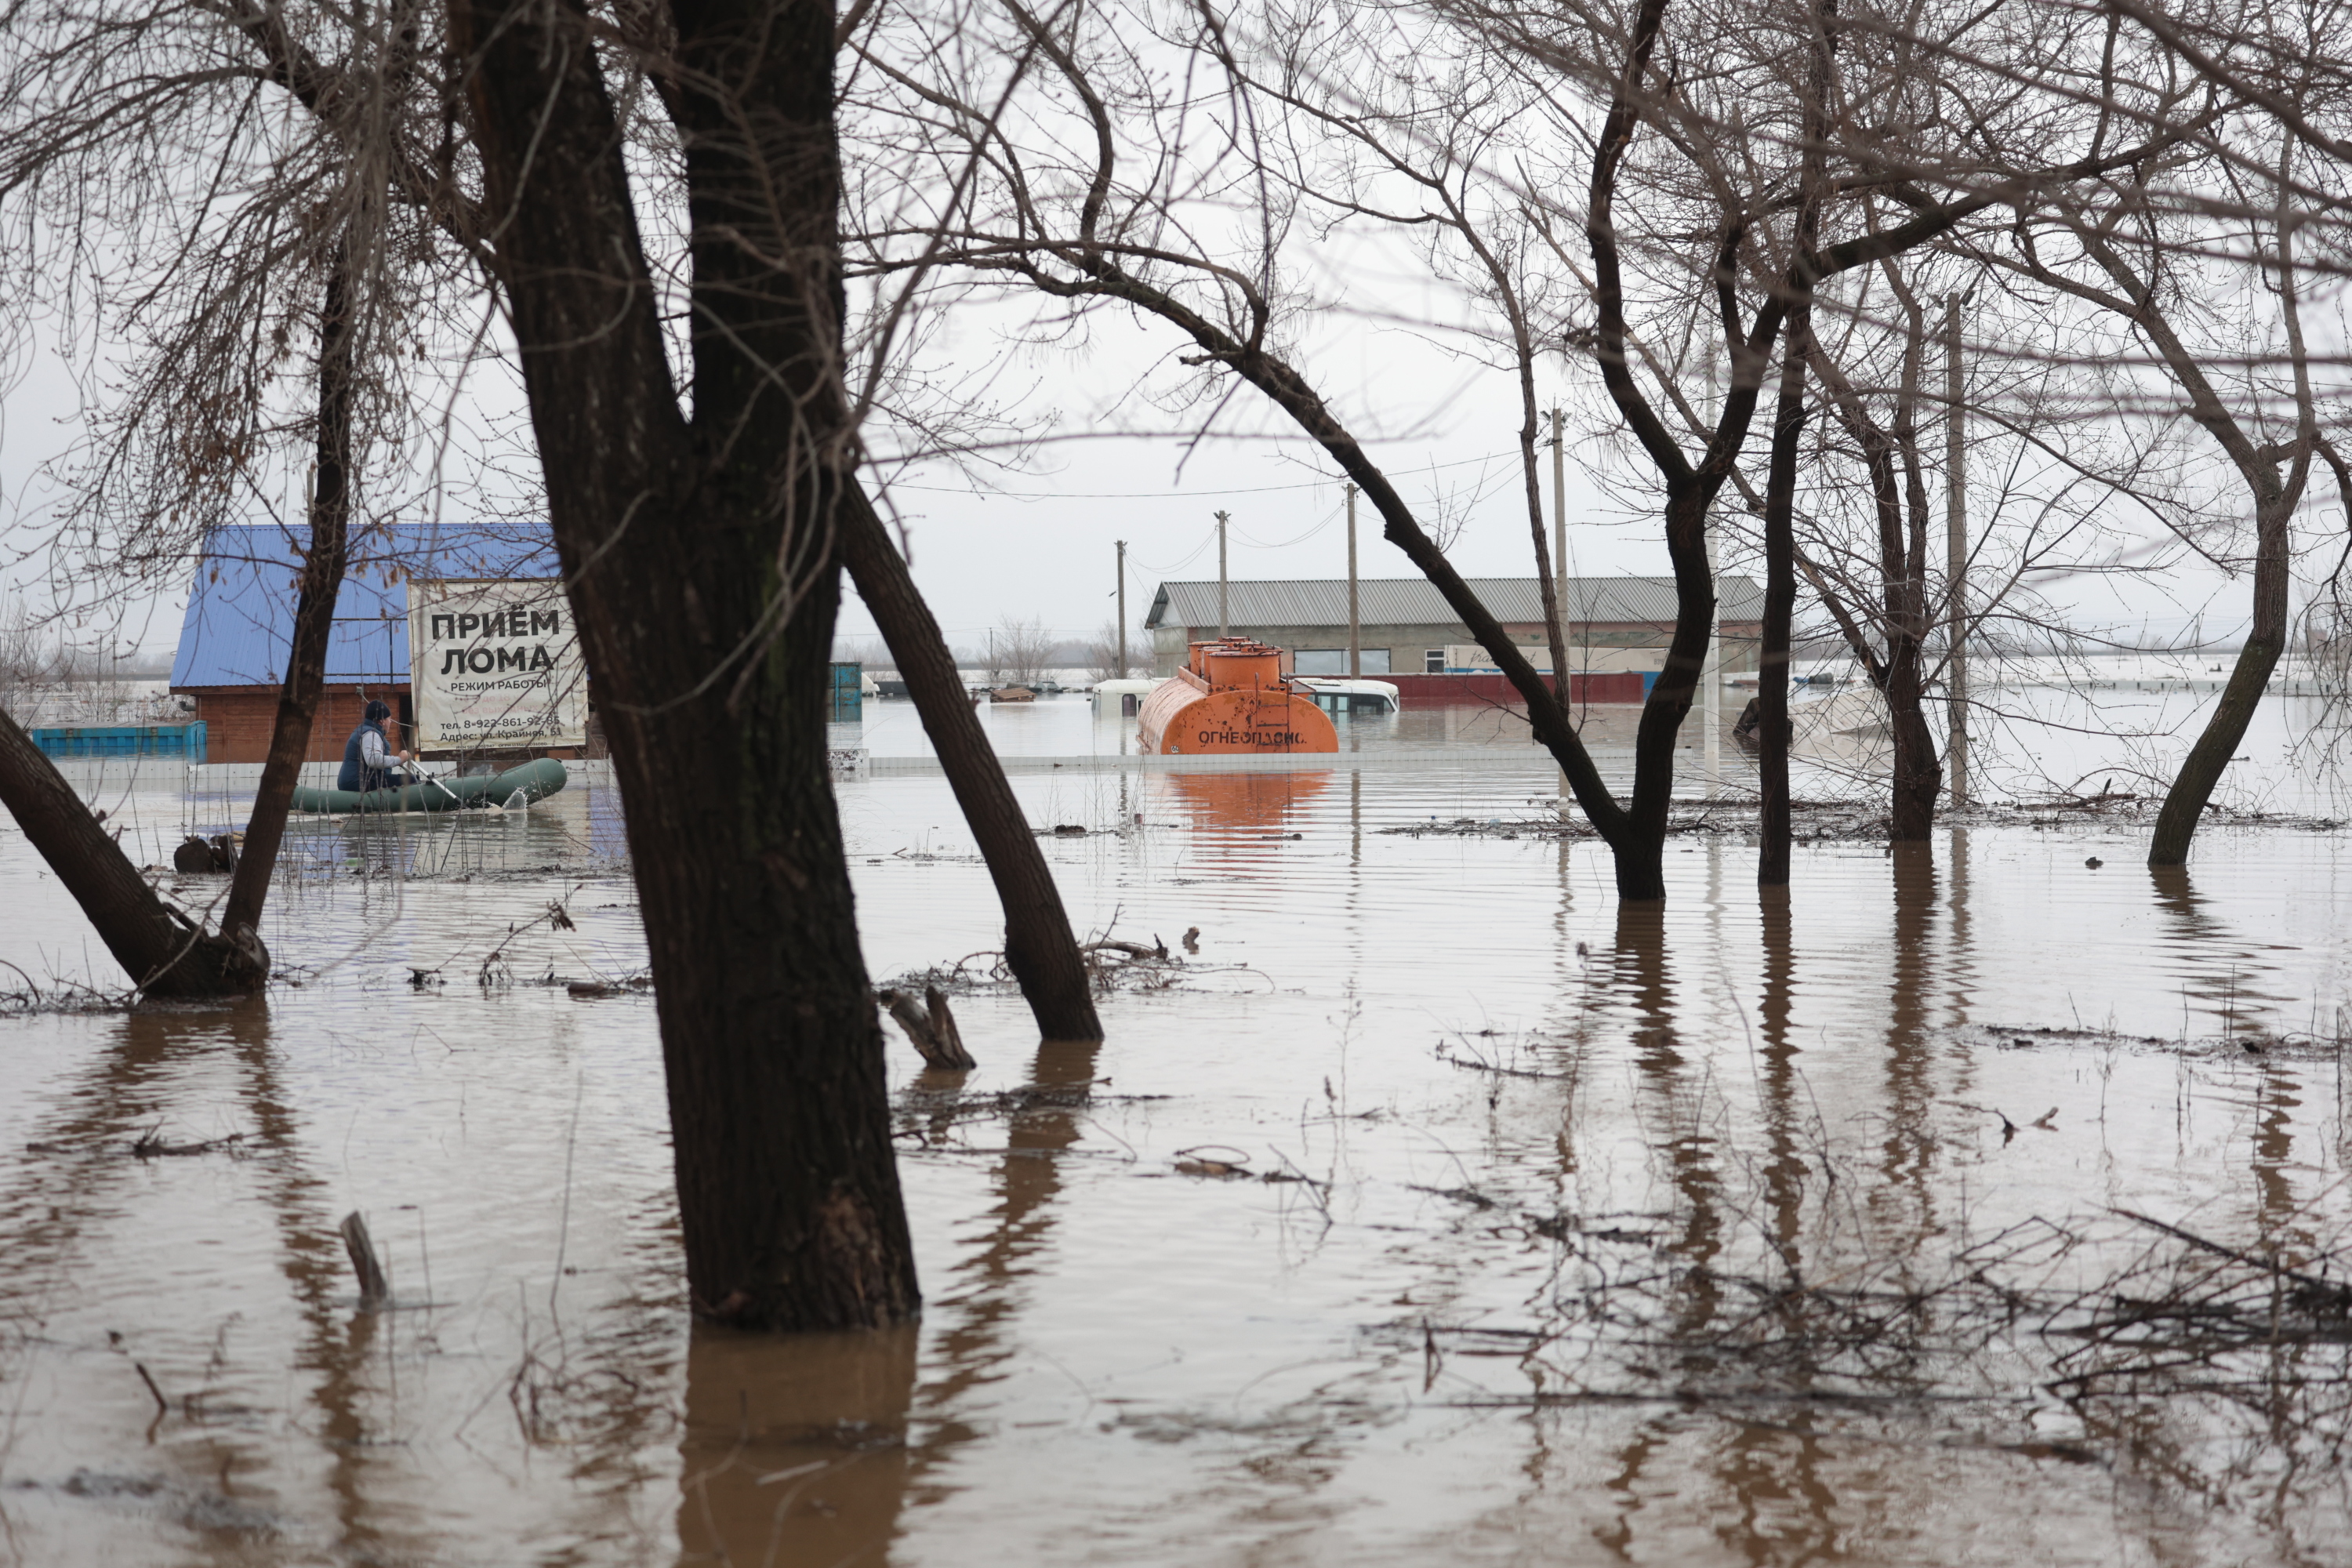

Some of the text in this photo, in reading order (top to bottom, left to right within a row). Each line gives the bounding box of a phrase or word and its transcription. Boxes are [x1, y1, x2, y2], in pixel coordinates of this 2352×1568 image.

[431, 604, 560, 640] ПРИЁМ
[441, 646, 555, 675] ЛОМА
[1470, 650, 1537, 663] trart
[451, 679, 546, 692] РЕЖИМ РАБОТЫ
[441, 716, 560, 730] тел. 8-922-861-92-85
[440, 733, 477, 742] Адрес:
